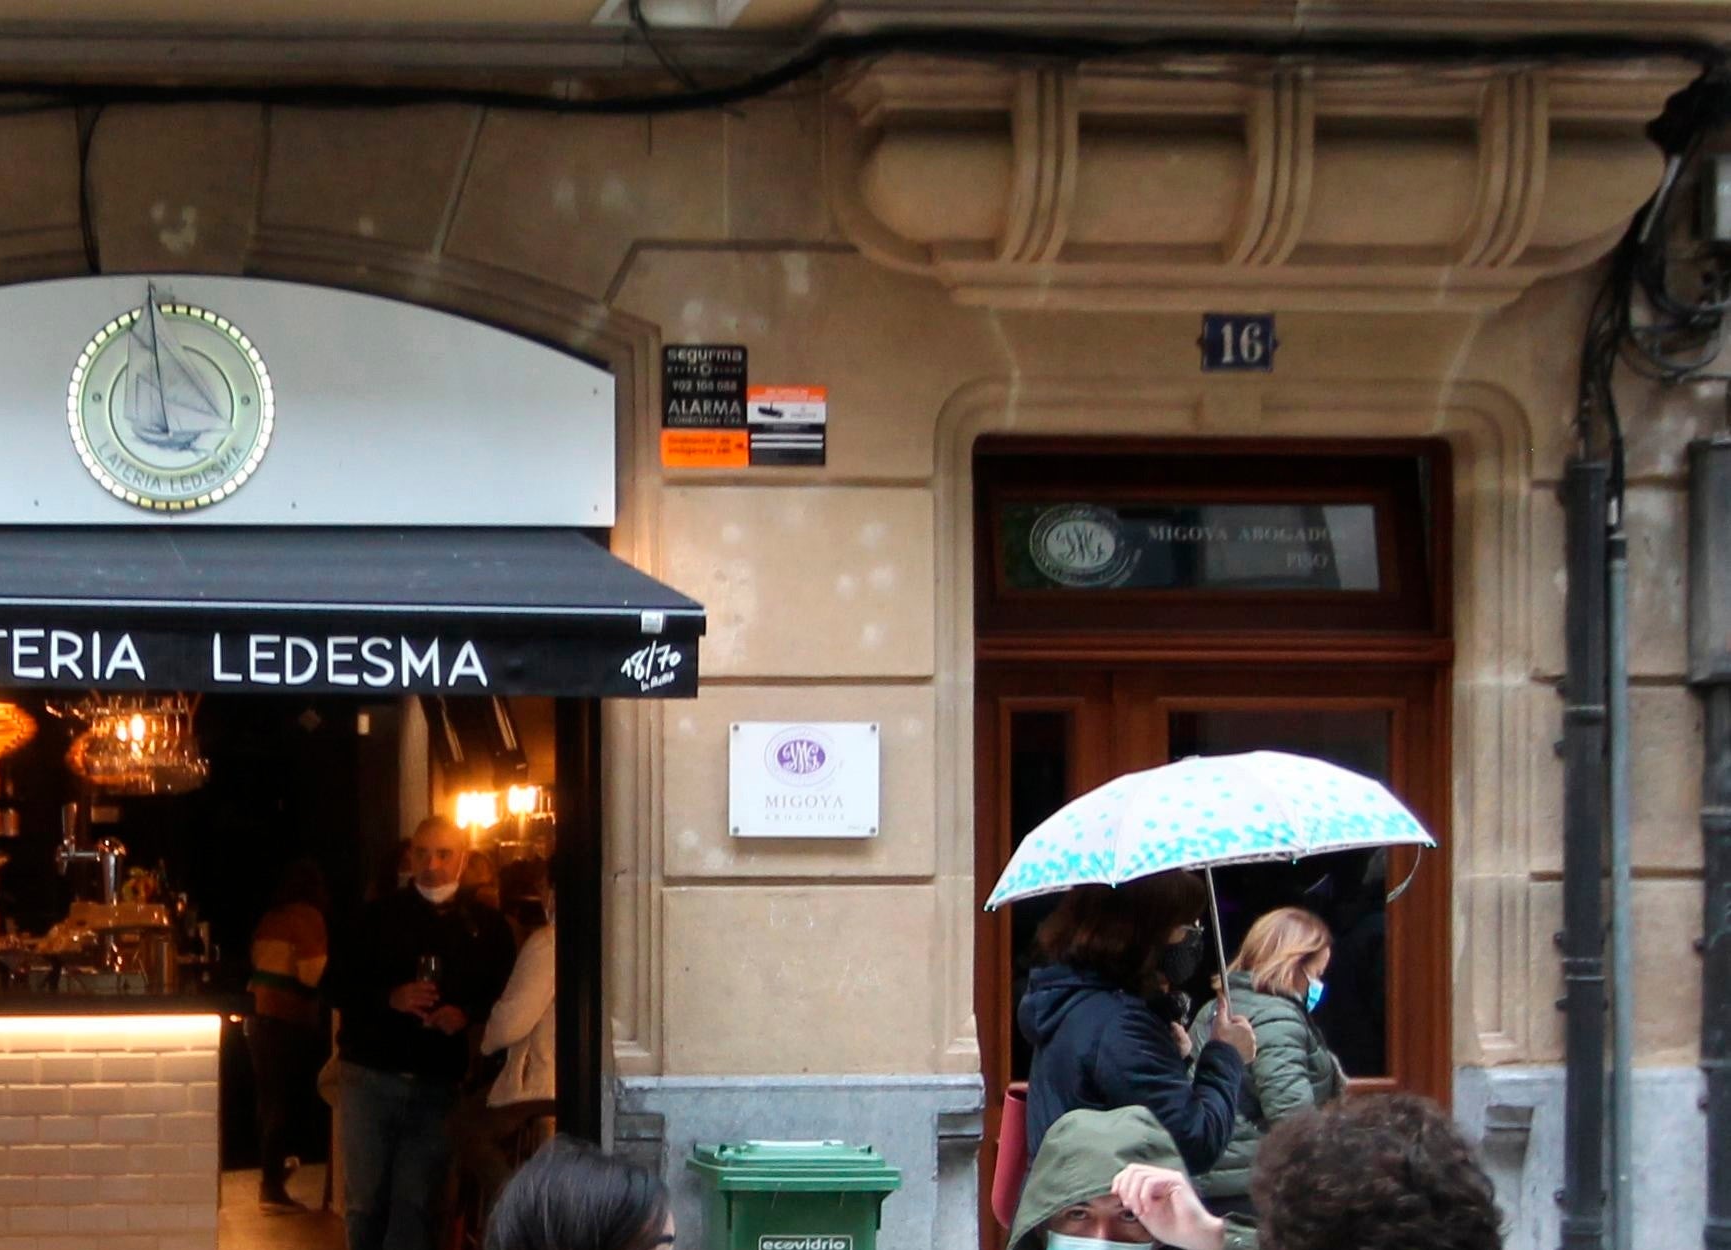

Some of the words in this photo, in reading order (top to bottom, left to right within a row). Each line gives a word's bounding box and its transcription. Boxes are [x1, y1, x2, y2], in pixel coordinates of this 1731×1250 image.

[1221, 322, 1263, 363] 16
[667, 349, 743, 364] segurma
[669, 399, 742, 416] ALARMA
[96, 440, 163, 493] LATERIA
[169, 444, 246, 494] LEDESMA
[1237, 525, 1346, 542] ABOGADO
[212, 633, 489, 688] LEDESMA
[620, 639, 682, 681] 18/70
[764, 794, 844, 809] MIGOYA
[762, 1238, 846, 1250] ecovidrio
